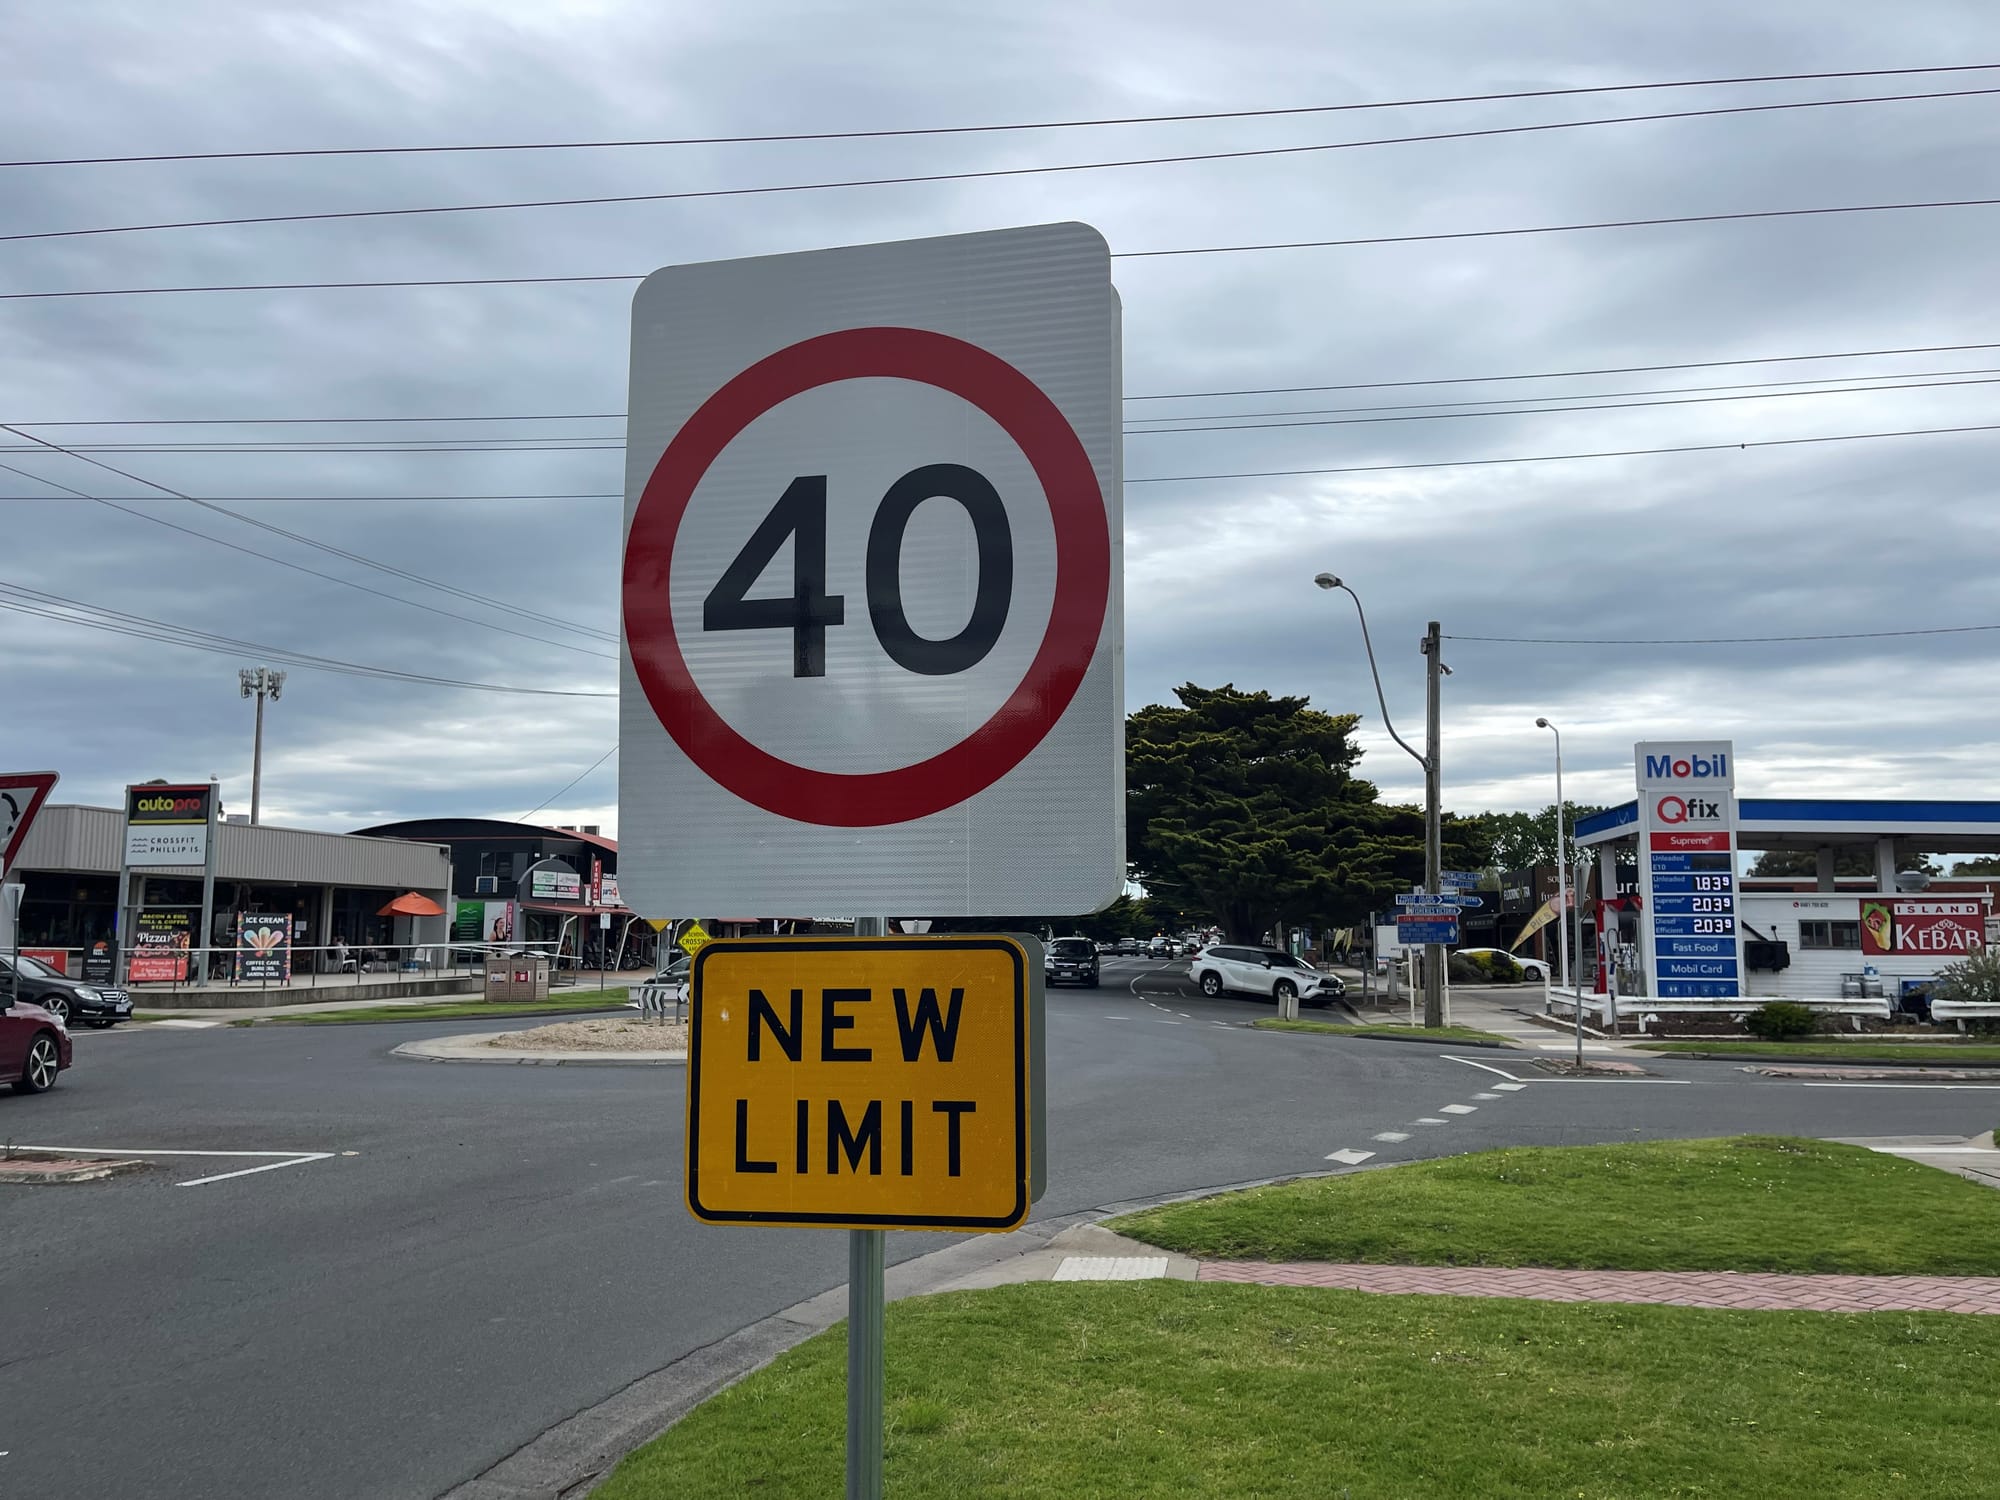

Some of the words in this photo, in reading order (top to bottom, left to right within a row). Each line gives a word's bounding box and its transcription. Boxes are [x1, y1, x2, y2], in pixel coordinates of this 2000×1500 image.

[703, 463, 1013, 678] 40
[1646, 754, 1727, 778] Mobil
[138, 796, 201, 815] autopro
[1657, 795, 1720, 825] Qfix
[1652, 863, 1666, 871] E10
[1547, 873, 1572, 883] souh
[1653, 875, 1686, 883] Unleaded
[1896, 905, 1976, 914] ISLAND
[245, 916, 258, 924] ICE
[259, 916, 285, 924] CREAM
[1896, 924, 1982, 950] KEBAB
[1672, 943, 1692, 952] Fast
[1694, 943, 1719, 952] Food
[1671, 964, 1698, 974] Mobil
[1700, 964, 1723, 974] Card
[747, 988, 965, 1062] NEW
[735, 1099, 977, 1177] LIMIT
